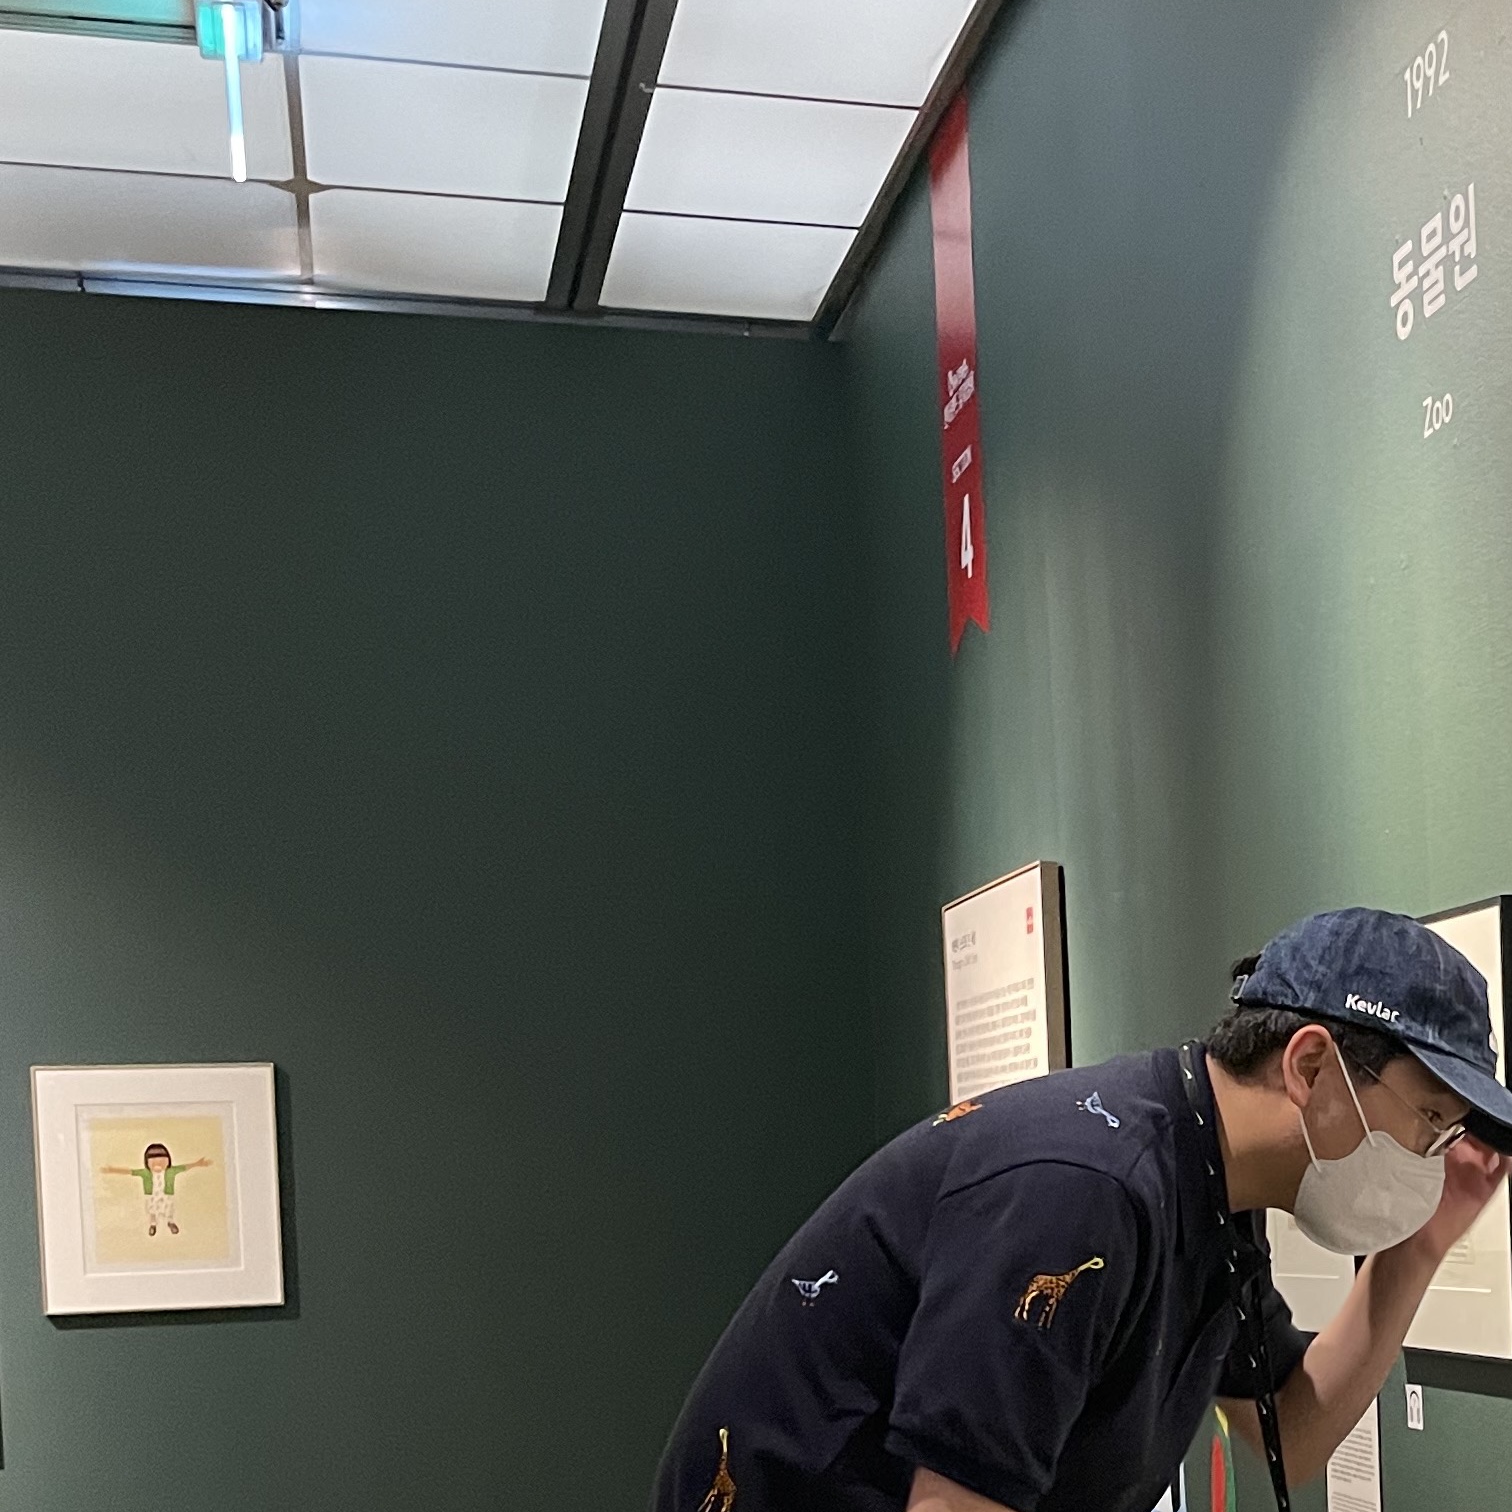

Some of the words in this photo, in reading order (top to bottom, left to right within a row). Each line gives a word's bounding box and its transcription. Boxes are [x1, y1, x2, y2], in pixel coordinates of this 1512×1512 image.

[1403, 29, 1451, 119] 1992
[1390, 182, 1479, 341] 동물원
[1422, 392, 1453, 439] Zoo
[960, 493, 974, 579] 4
[1345, 993, 1400, 1023] Kevlar
